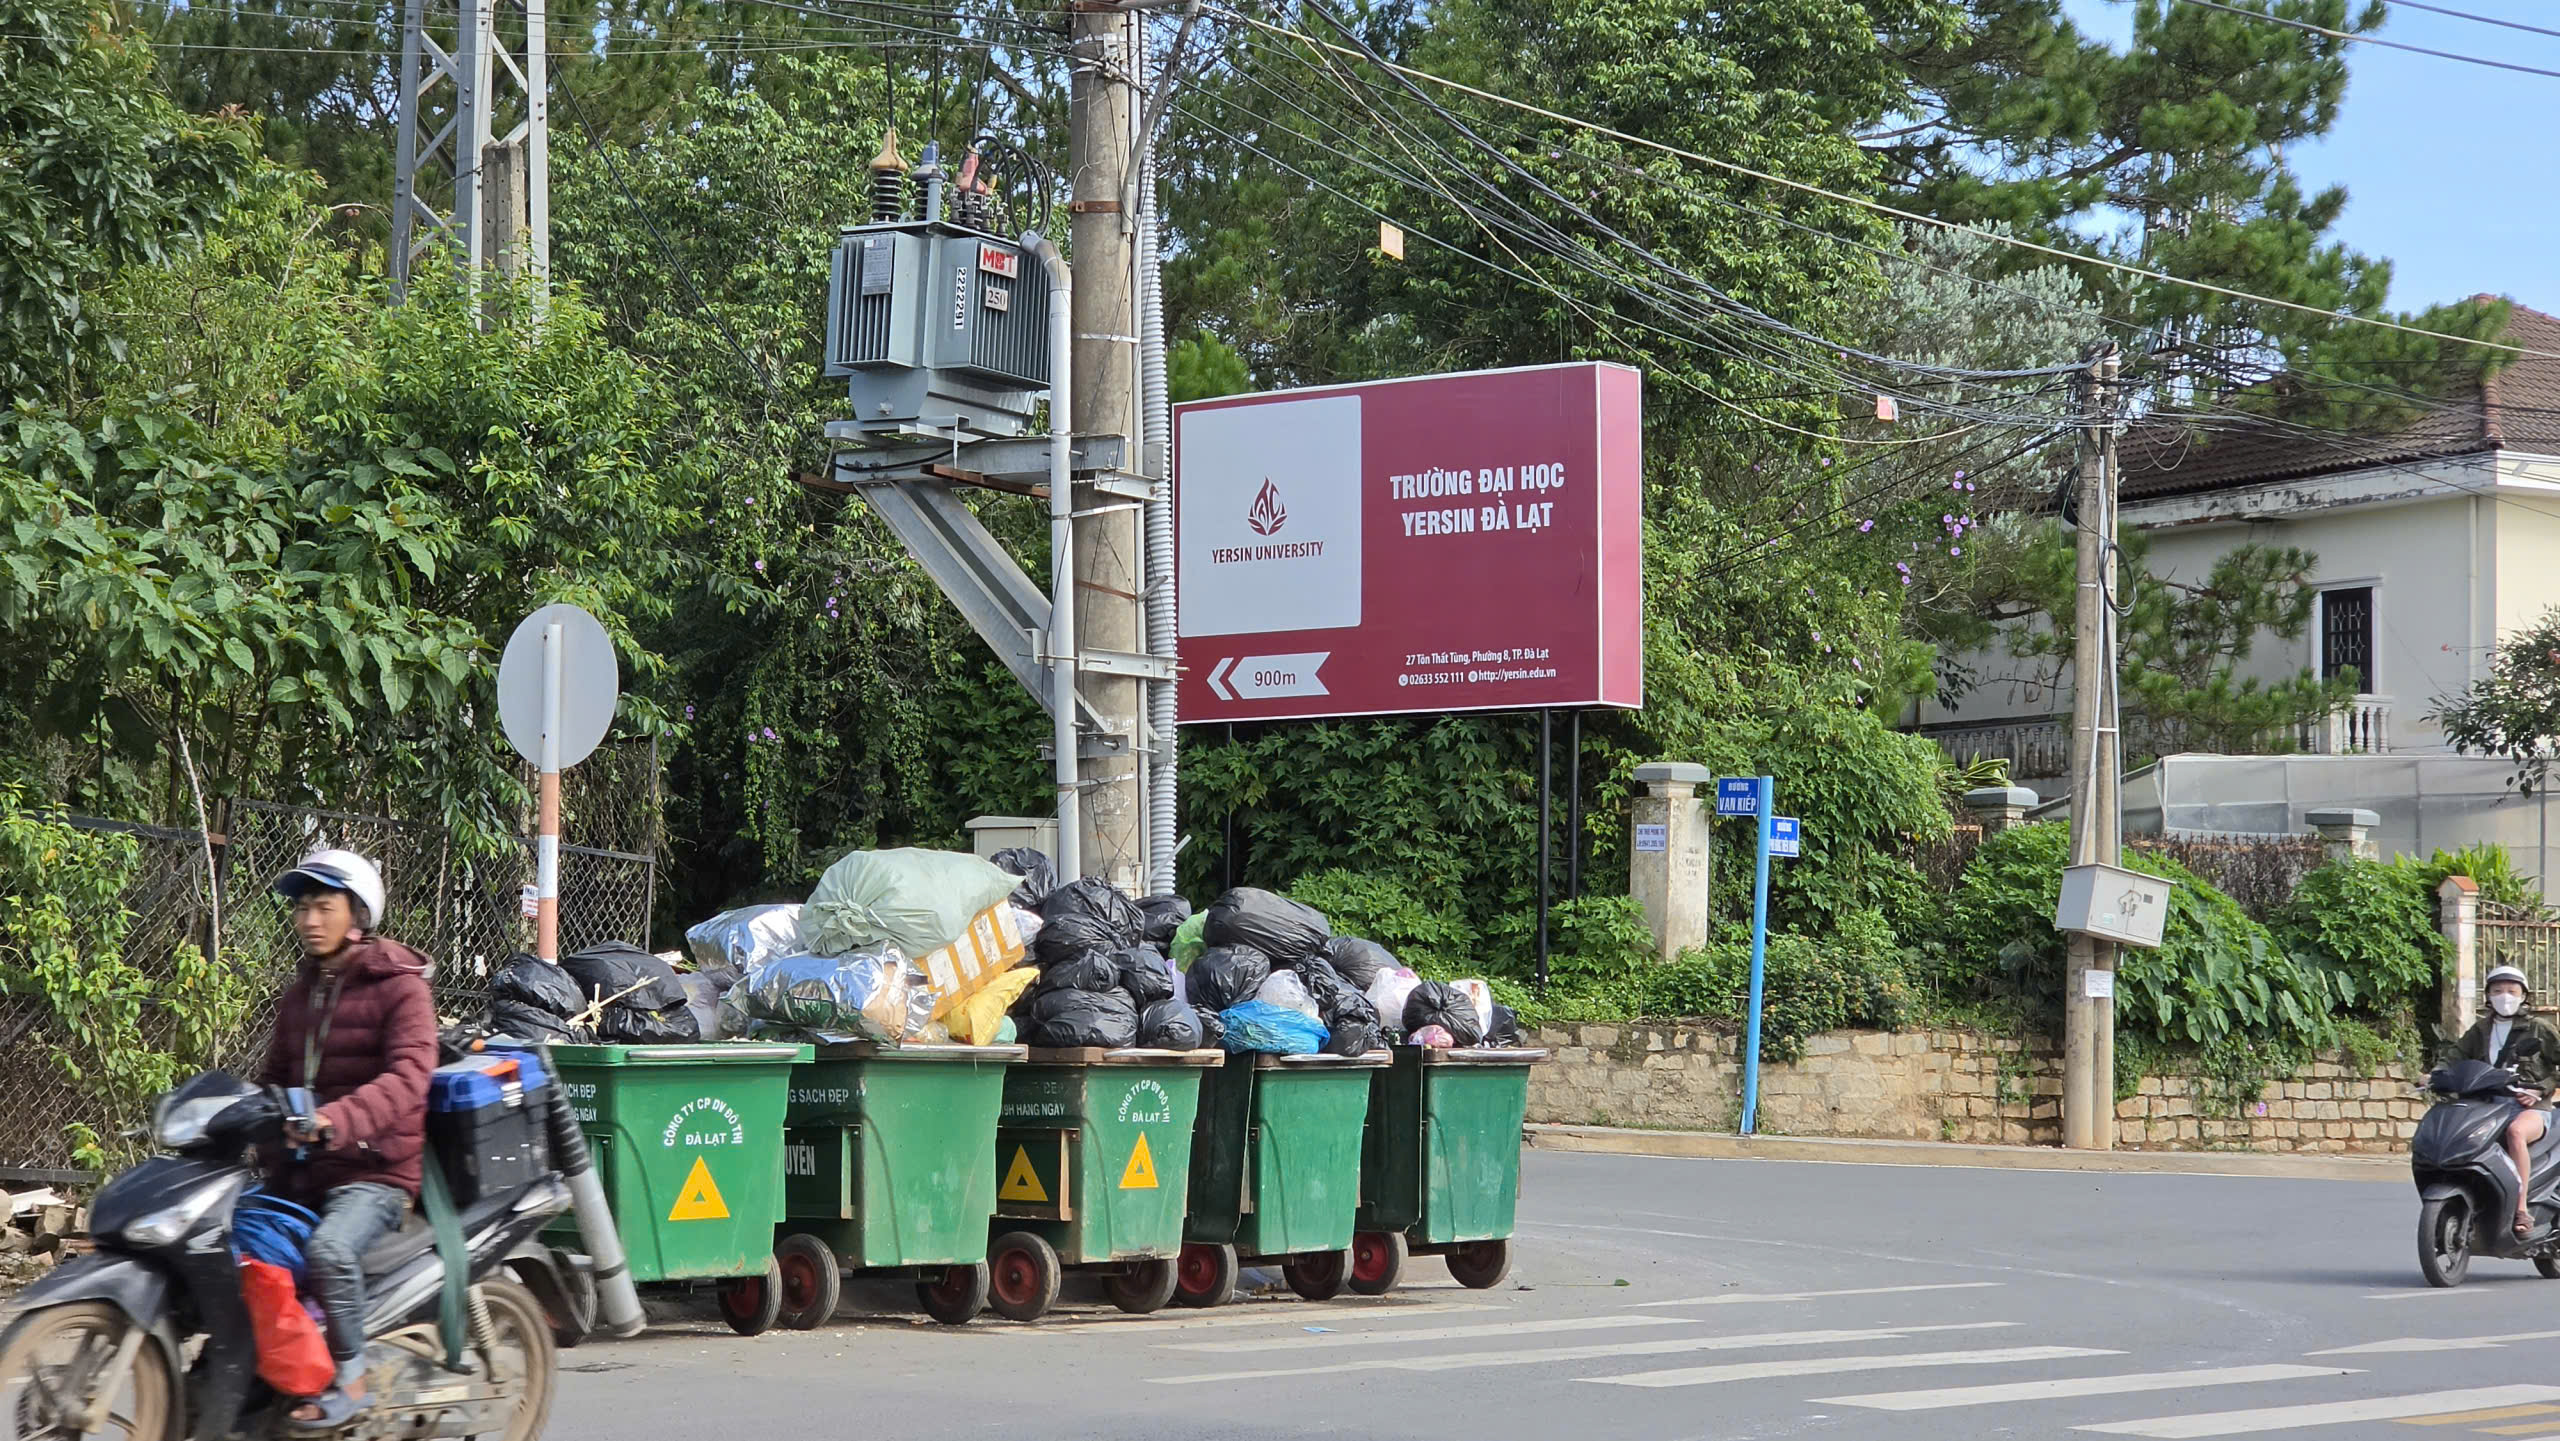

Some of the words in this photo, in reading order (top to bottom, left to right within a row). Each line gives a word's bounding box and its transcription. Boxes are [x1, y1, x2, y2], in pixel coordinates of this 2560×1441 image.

[982, 248, 1014, 273] MBT
[955, 268, 966, 326] 2222291
[988, 290, 1006, 306] 250
[1390, 466, 1472, 500] TRƯỜNG
[1478, 466, 1513, 497] ĐẠI
[1520, 462, 1565, 494] HỌC
[1401, 508, 1475, 537] YERSIN
[1481, 500, 1510, 532] ĐÀ
[1516, 502, 1553, 534] LẠT
[1212, 547, 1252, 564] YERSIN
[1255, 541, 1324, 560] UNIVERSITY
[1405, 655, 1416, 666] 27
[1416, 653, 1430, 665] Tôn
[1431, 652, 1449, 664] Thất
[1449, 652, 1471, 665] Tùng,
[1472, 650, 1502, 664] Phường
[1503, 649, 1511, 662] 8,
[1512, 649, 1523, 660] TP.
[1524, 648, 1535, 659] Đà
[1536, 648, 1549, 661] Lạt
[1255, 670, 1296, 687] 900m
[1409, 673, 1433, 685] 02633
[1434, 673, 1449, 684] 552
[1450, 672, 1464, 683] 111
[1478, 667, 1557, 683] http://yersin.edu.vn
[580, 1084, 596, 1101] ĐẸP
[1130, 1082, 1140, 1096] TY
[1141, 1079, 1151, 1090] CP
[799, 1088, 826, 1106] SẠCH
[828, 1088, 849, 1106] ĐẸP
[663, 1113, 684, 1147] CÔNG
[680, 1101, 694, 1116] TY
[696, 1097, 711, 1110] CP
[711, 1098, 727, 1113] DV
[723, 1107, 739, 1125] ĐÔ
[685, 1131, 702, 1145] ĐÀ
[704, 1132, 727, 1147] LẠT
[784, 1139, 816, 1176] UYÊN
